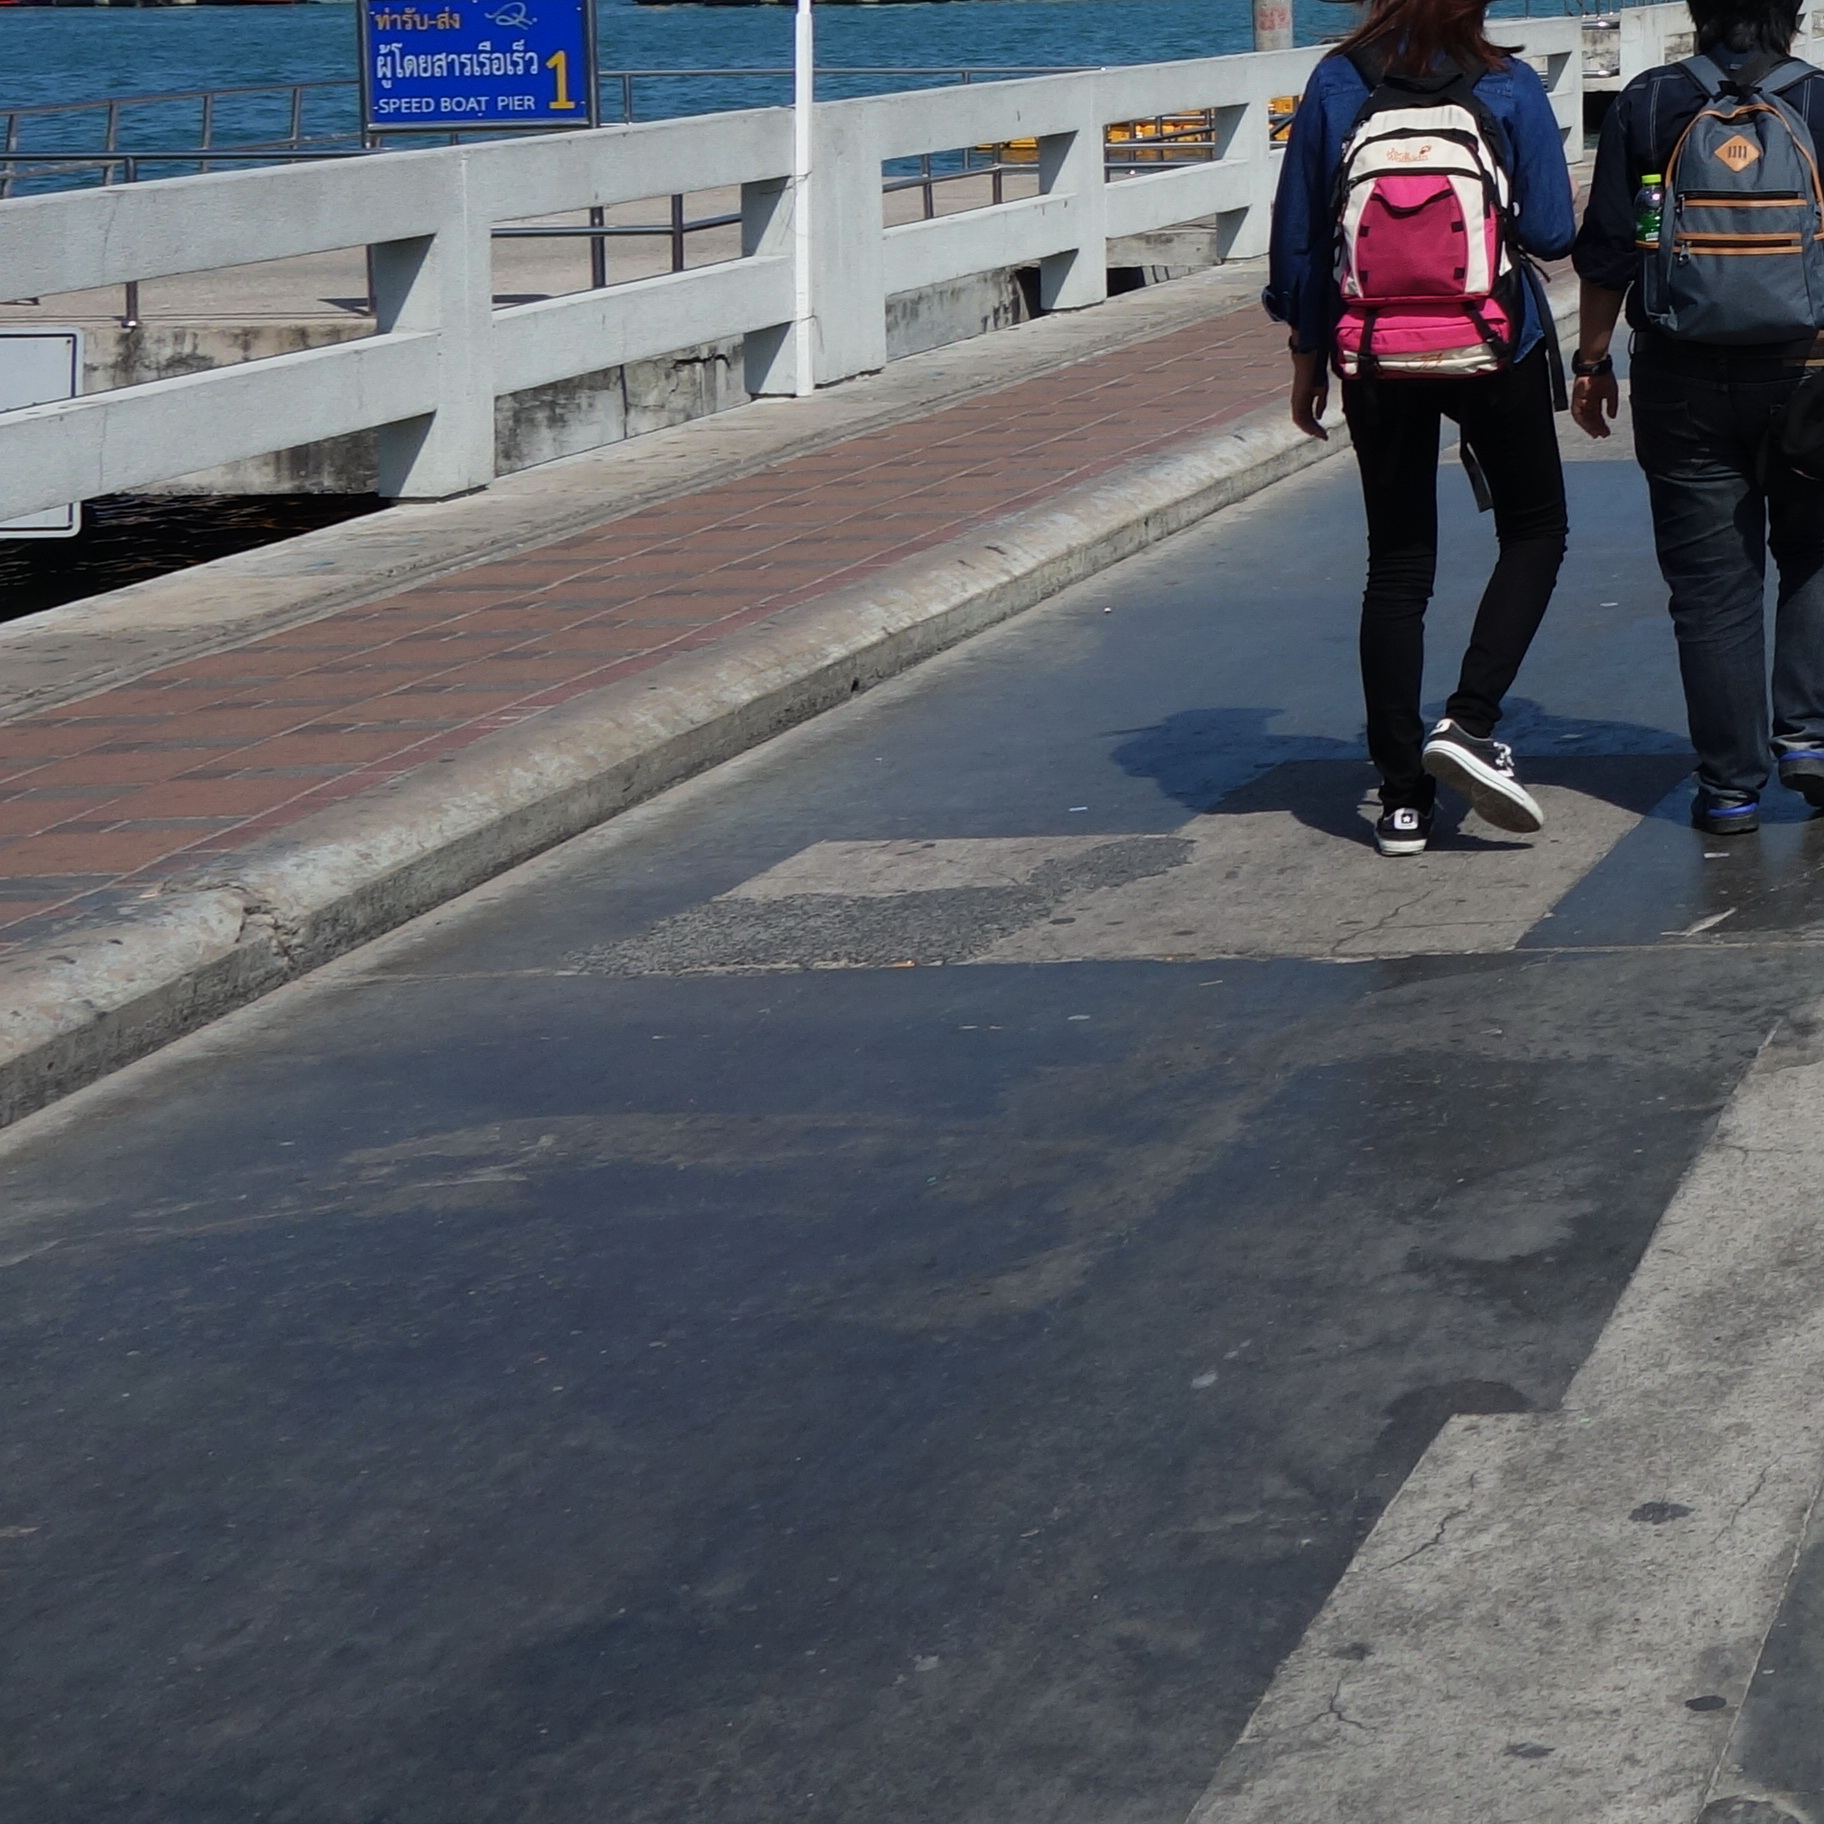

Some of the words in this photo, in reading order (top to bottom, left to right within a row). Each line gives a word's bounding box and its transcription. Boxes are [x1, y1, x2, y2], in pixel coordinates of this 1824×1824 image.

[375, 6, 461, 31] ท่ารับ-ส่ง
[376, 39, 539, 89] ผู้โดยสารเรือเร็ว
[378, 98, 435, 114] SPEED
[440, 96, 489, 112] BOAT
[497, 96, 536, 111] PIER
[546, 50, 576, 109] 1
